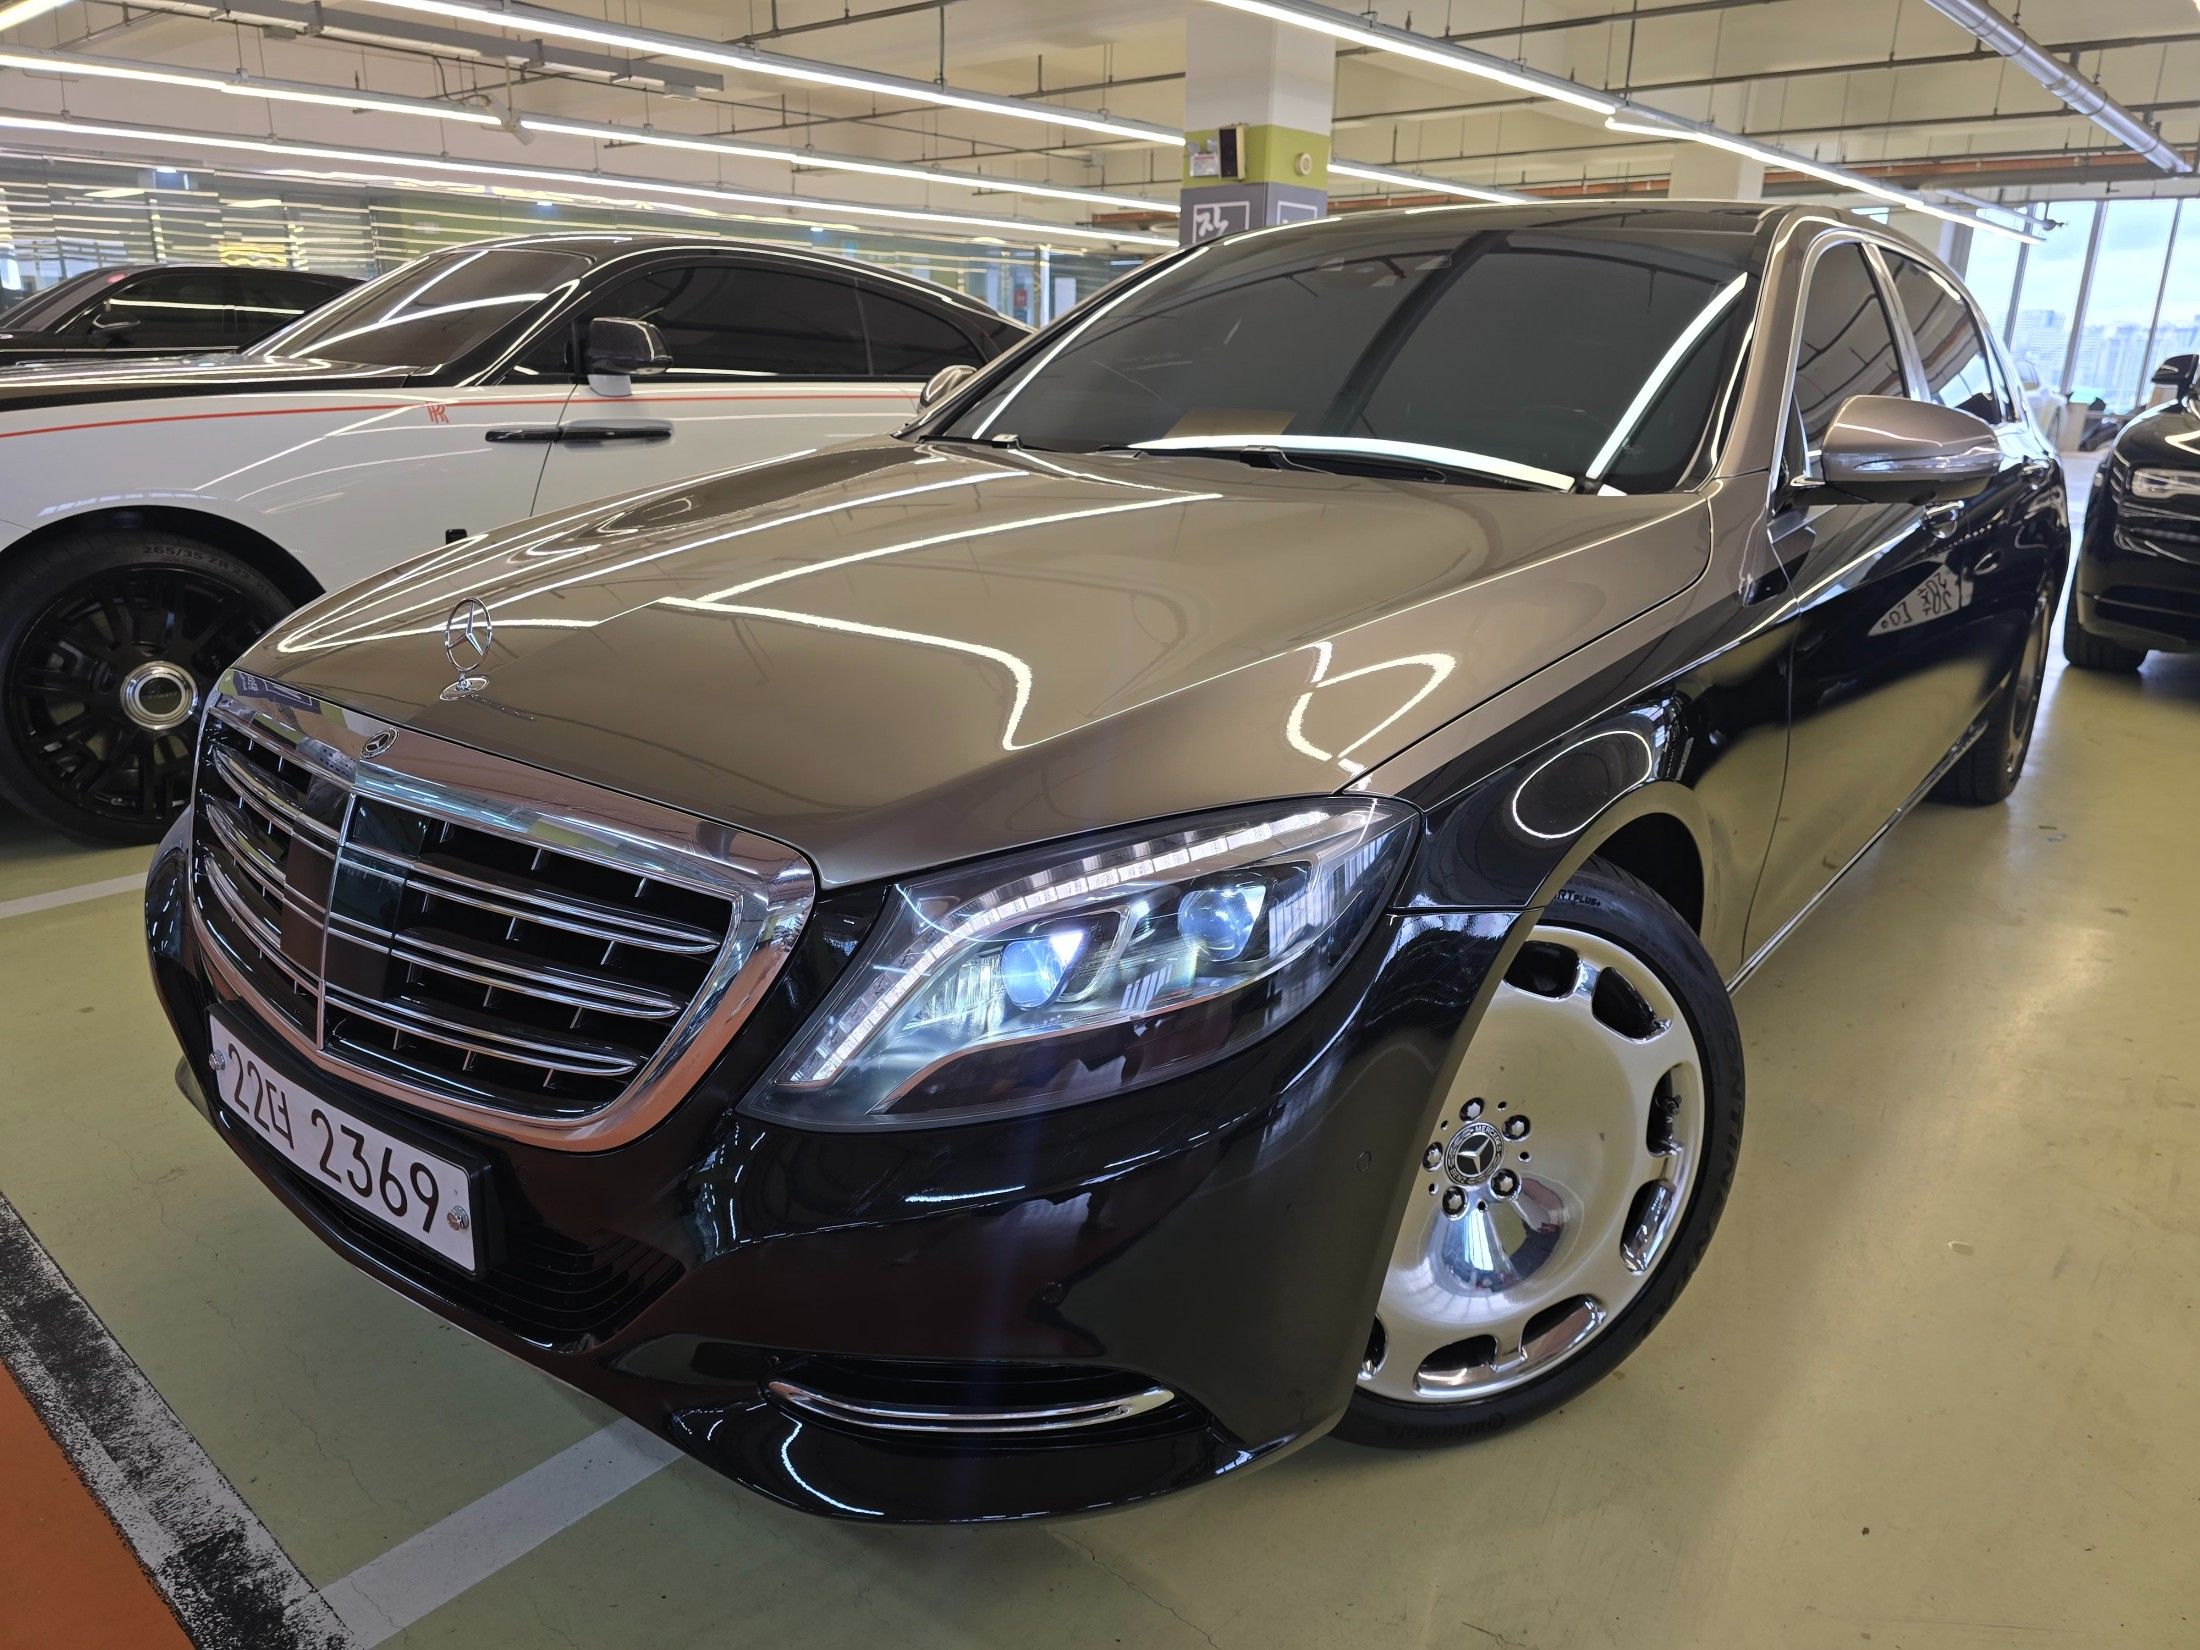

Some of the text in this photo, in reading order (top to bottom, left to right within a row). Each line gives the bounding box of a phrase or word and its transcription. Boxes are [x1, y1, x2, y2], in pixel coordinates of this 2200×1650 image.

[228, 1043, 439, 1234] 22더 2369
[1475, 1125, 1502, 1152] MERCEDES
[1450, 1168, 1467, 1184] BENZ
